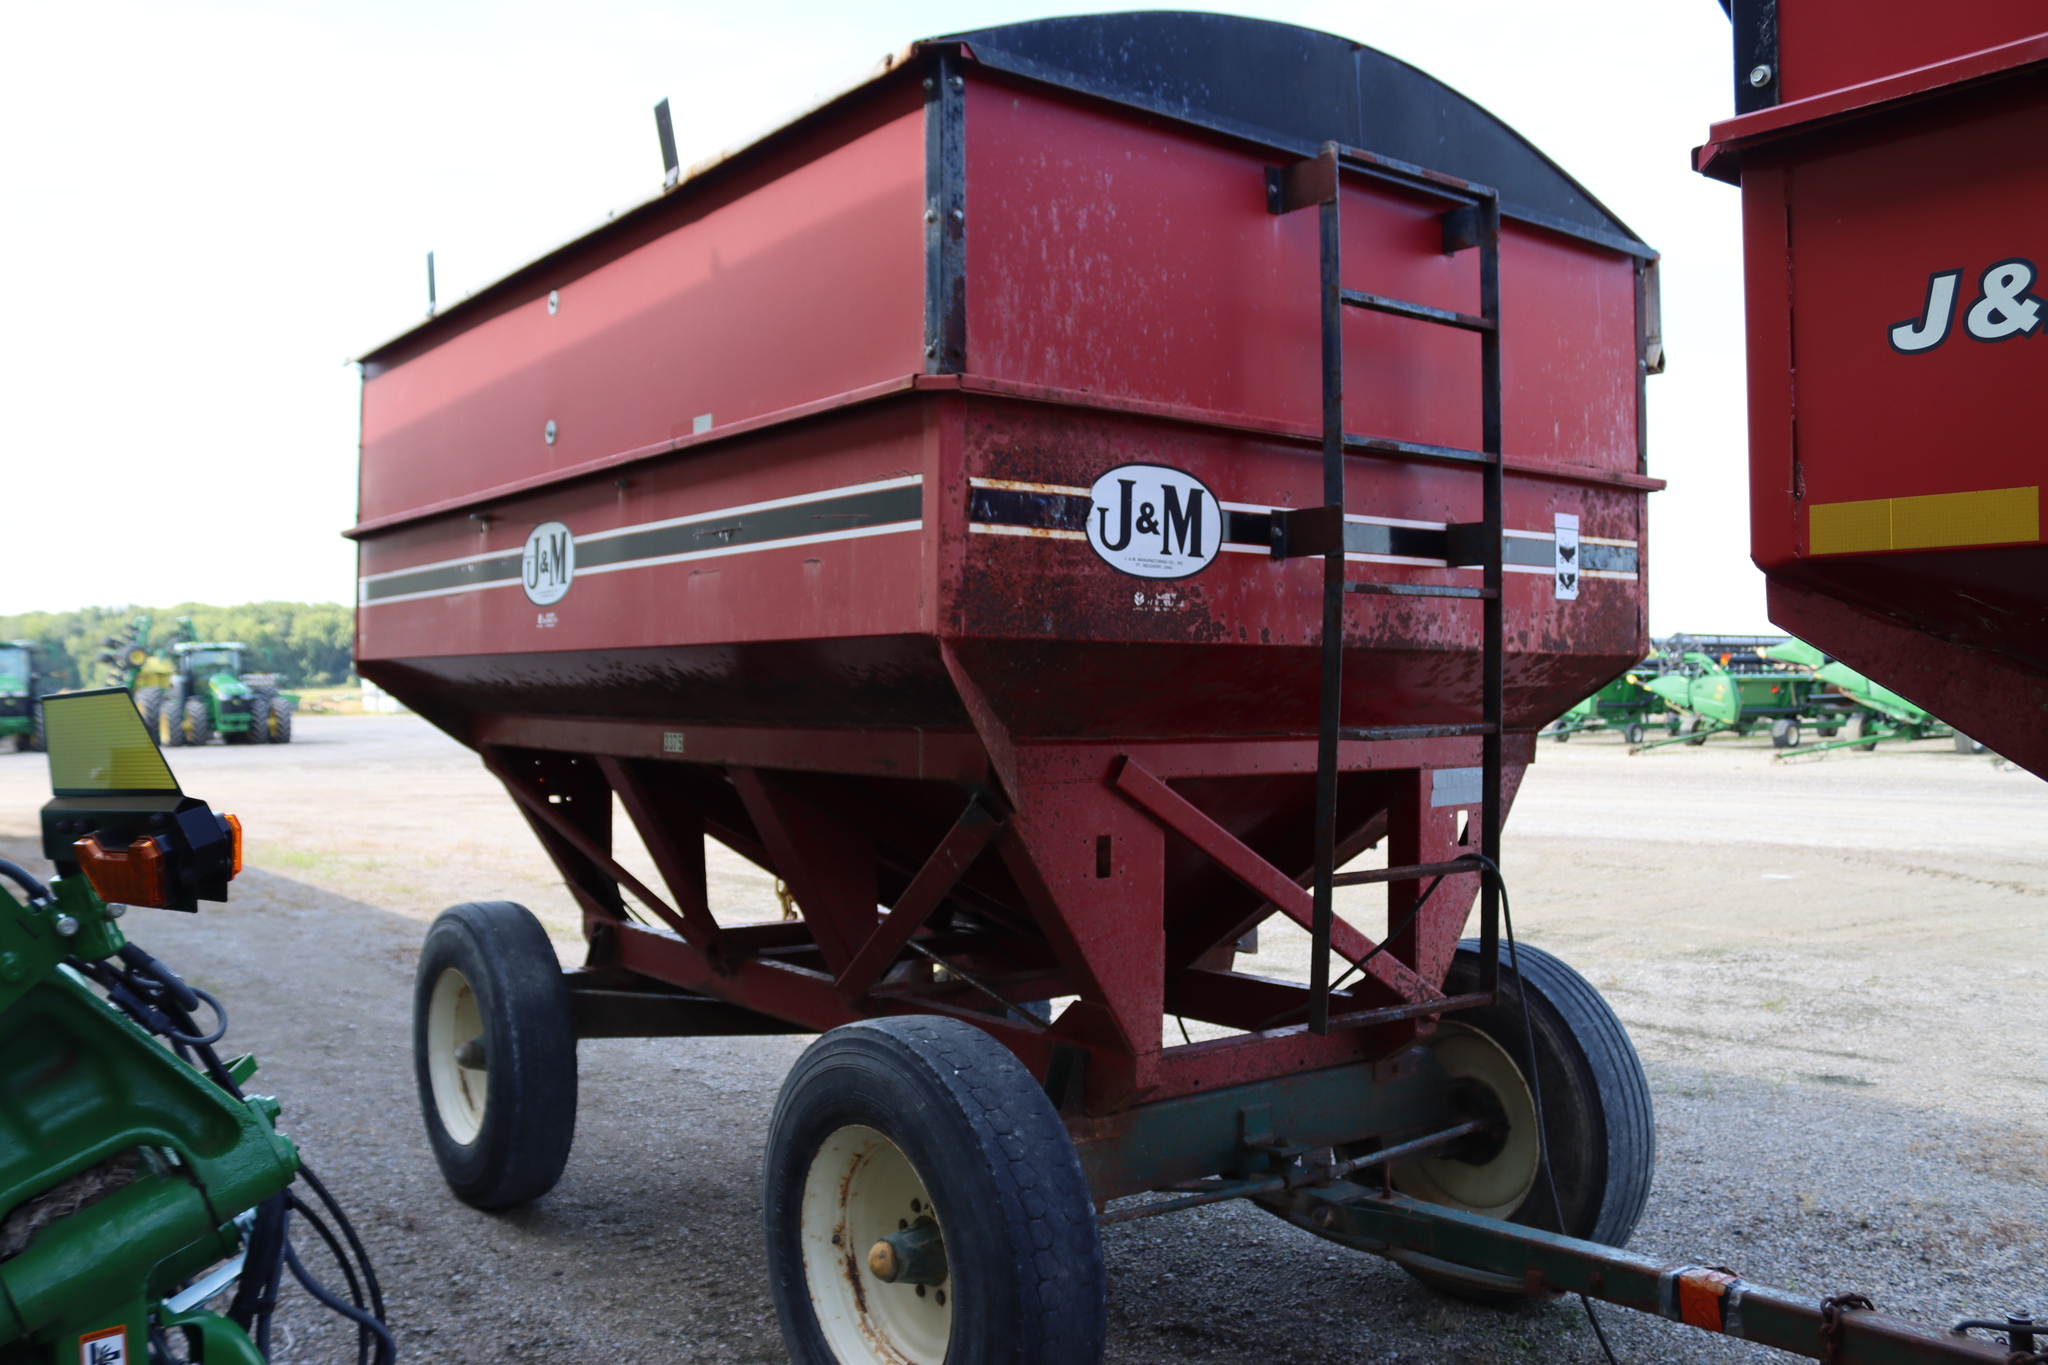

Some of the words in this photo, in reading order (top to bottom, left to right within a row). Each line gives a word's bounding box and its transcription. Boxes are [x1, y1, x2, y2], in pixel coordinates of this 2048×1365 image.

[1887, 257, 2048, 356] J&
[1097, 478, 1205, 559] J&M
[526, 531, 567, 590] J&M
